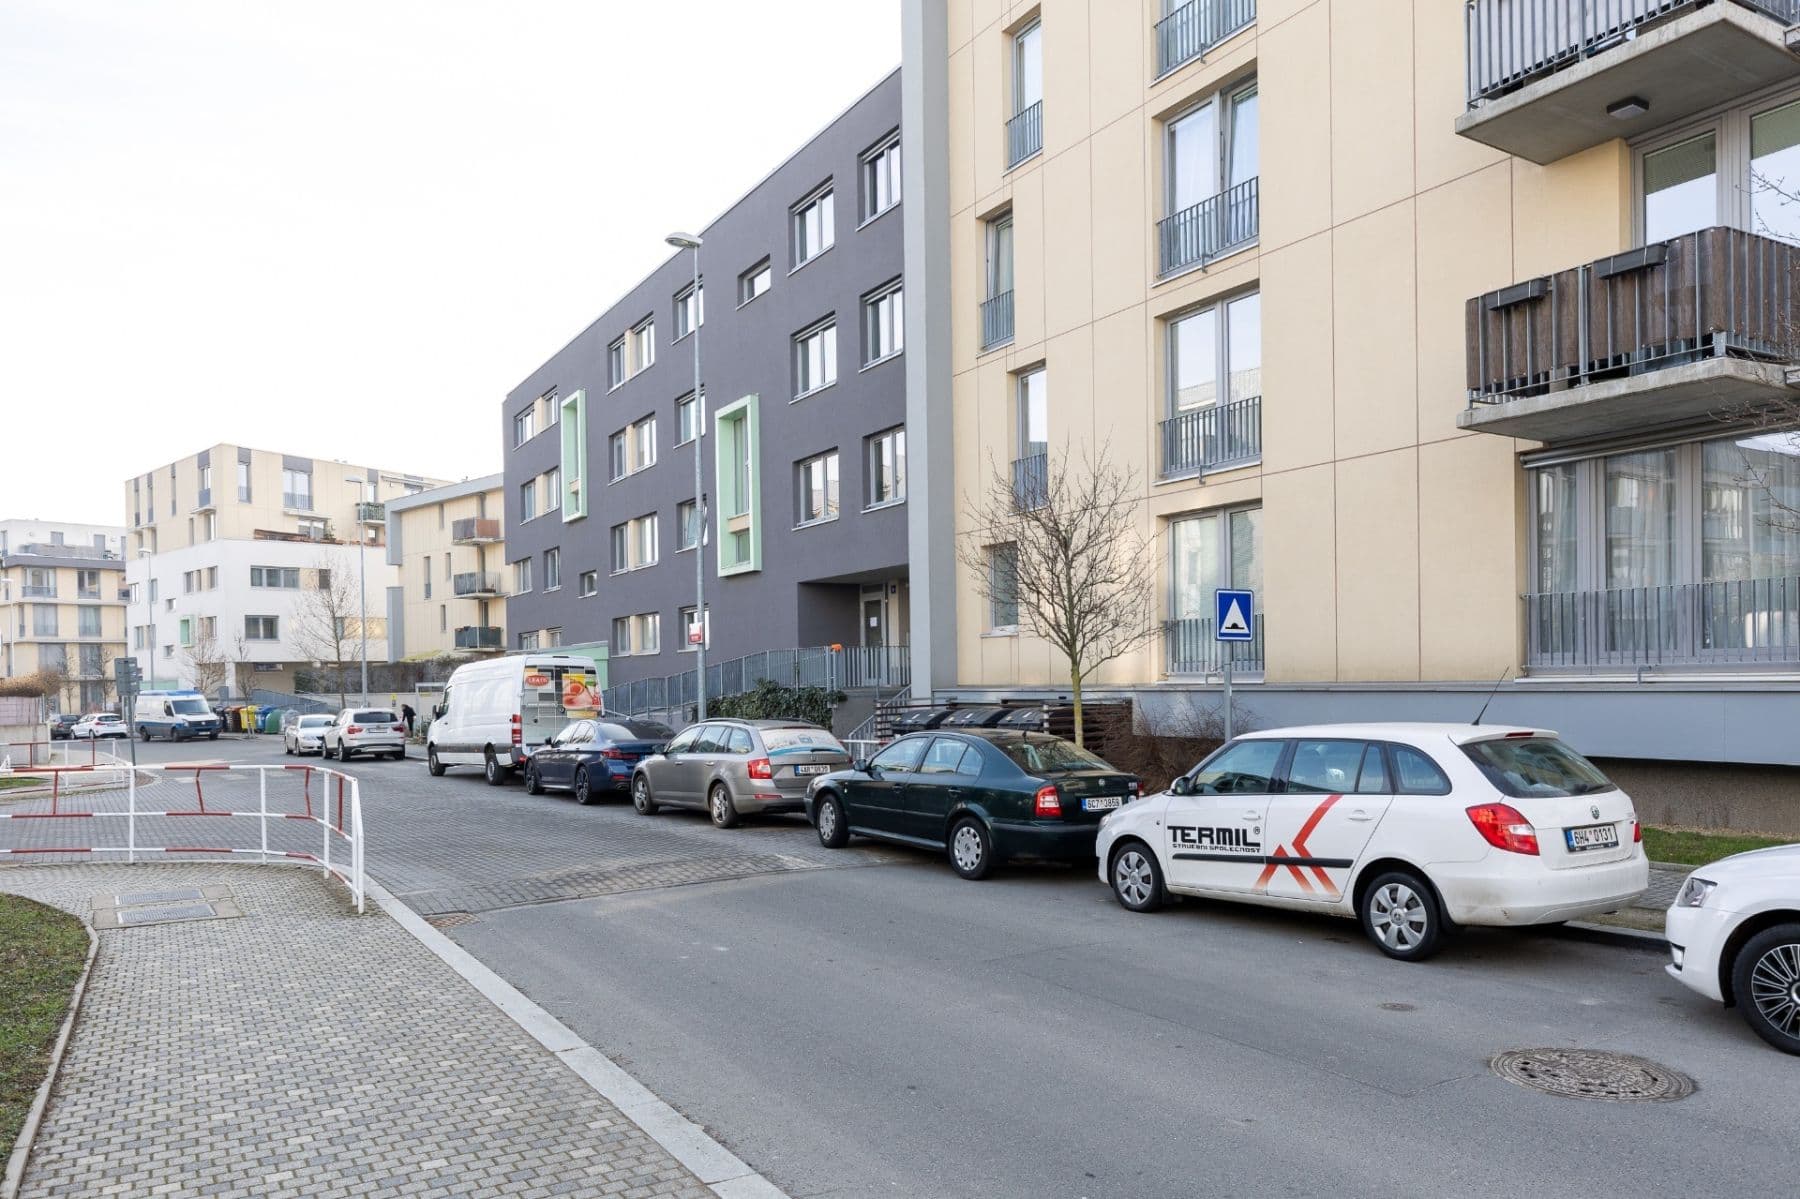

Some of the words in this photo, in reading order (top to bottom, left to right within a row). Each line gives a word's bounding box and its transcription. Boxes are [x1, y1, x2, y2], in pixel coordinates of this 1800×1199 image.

[1167, 826, 1260, 847] TERMIL
[1573, 830, 1590, 845] 6H4
[1593, 827, 1613, 842] 0131
